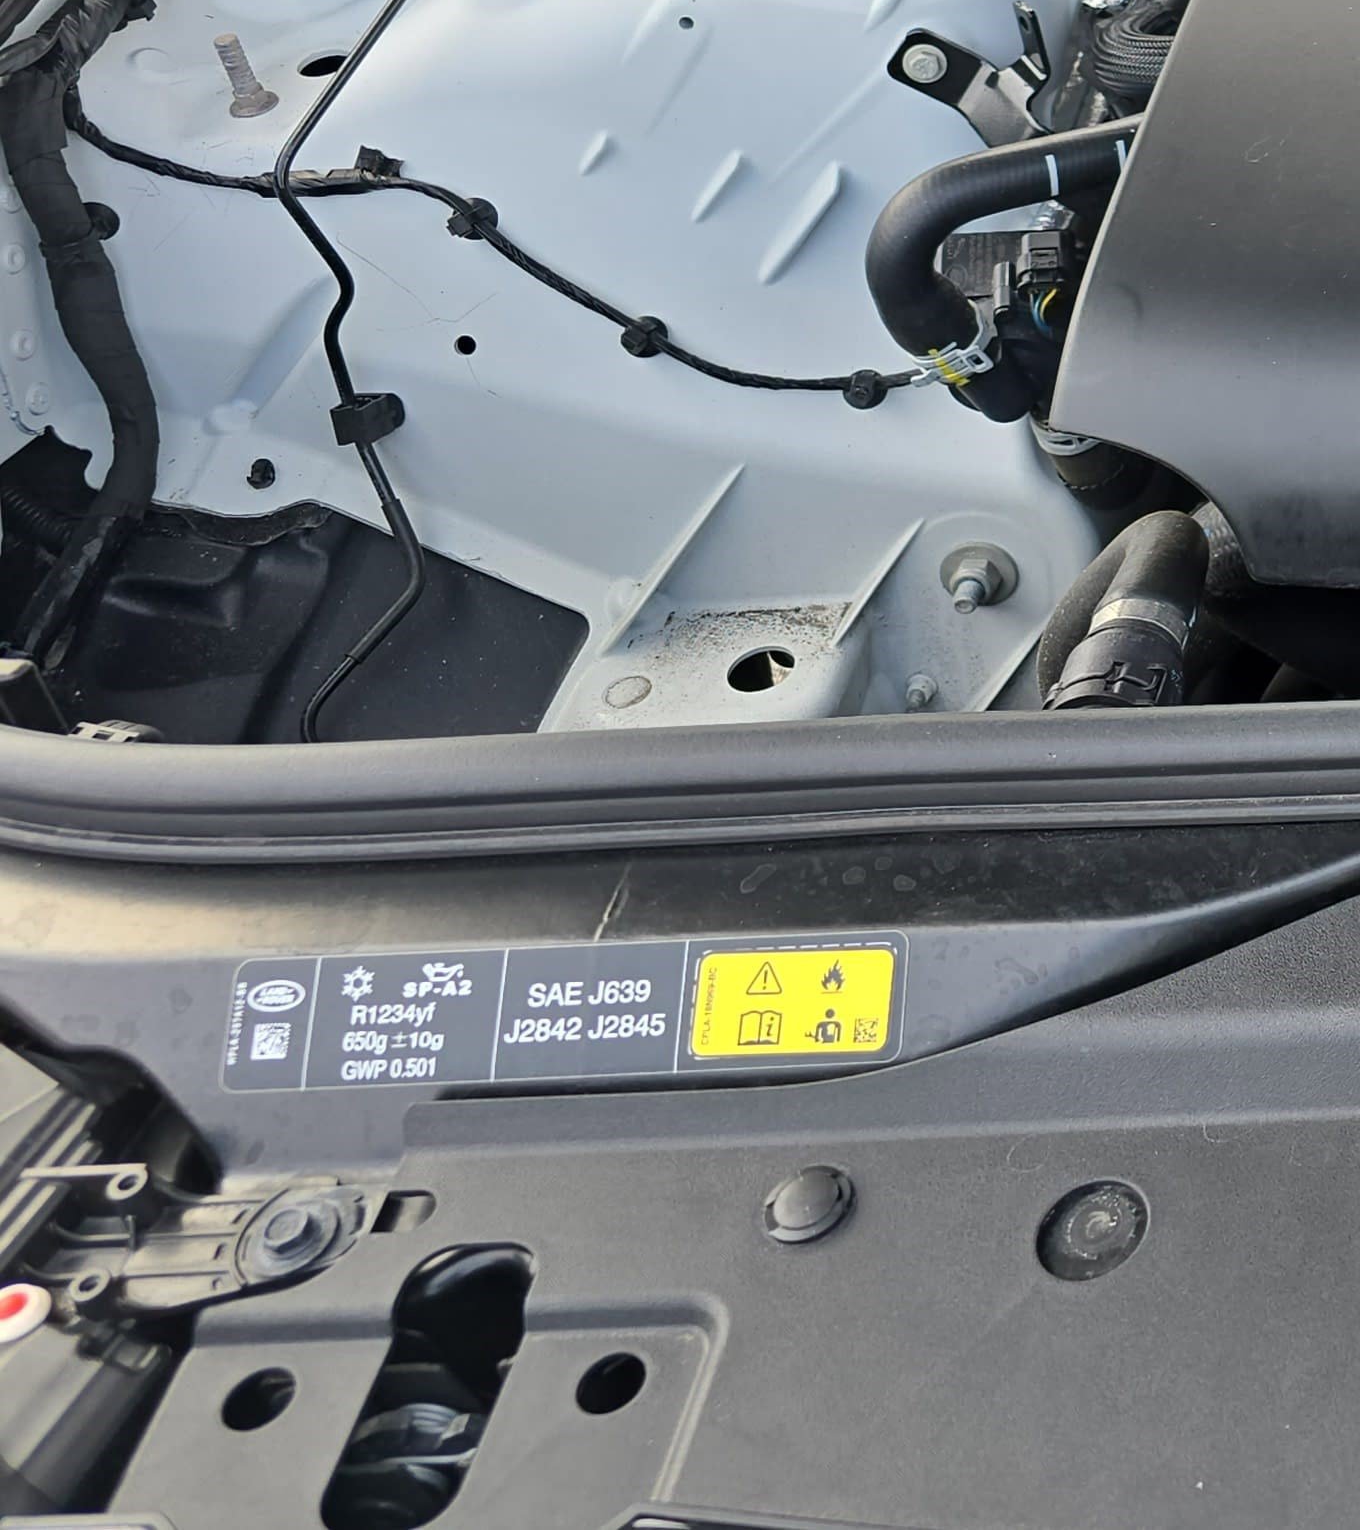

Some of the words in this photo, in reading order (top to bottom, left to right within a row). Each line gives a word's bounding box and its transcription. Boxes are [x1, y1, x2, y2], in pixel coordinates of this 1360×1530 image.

[402, 979, 473, 998] SP-A2
[527, 981, 584, 1007] SAE
[587, 979, 651, 1005] J639
[351, 1001, 437, 1027] R1234yf
[503, 1016, 582, 1044] J2842
[587, 1013, 666, 1040] J2845
[341, 1030, 388, 1055] 650g
[341, 1058, 388, 1080] GWP
[389, 1056, 437, 1078] 0.501
